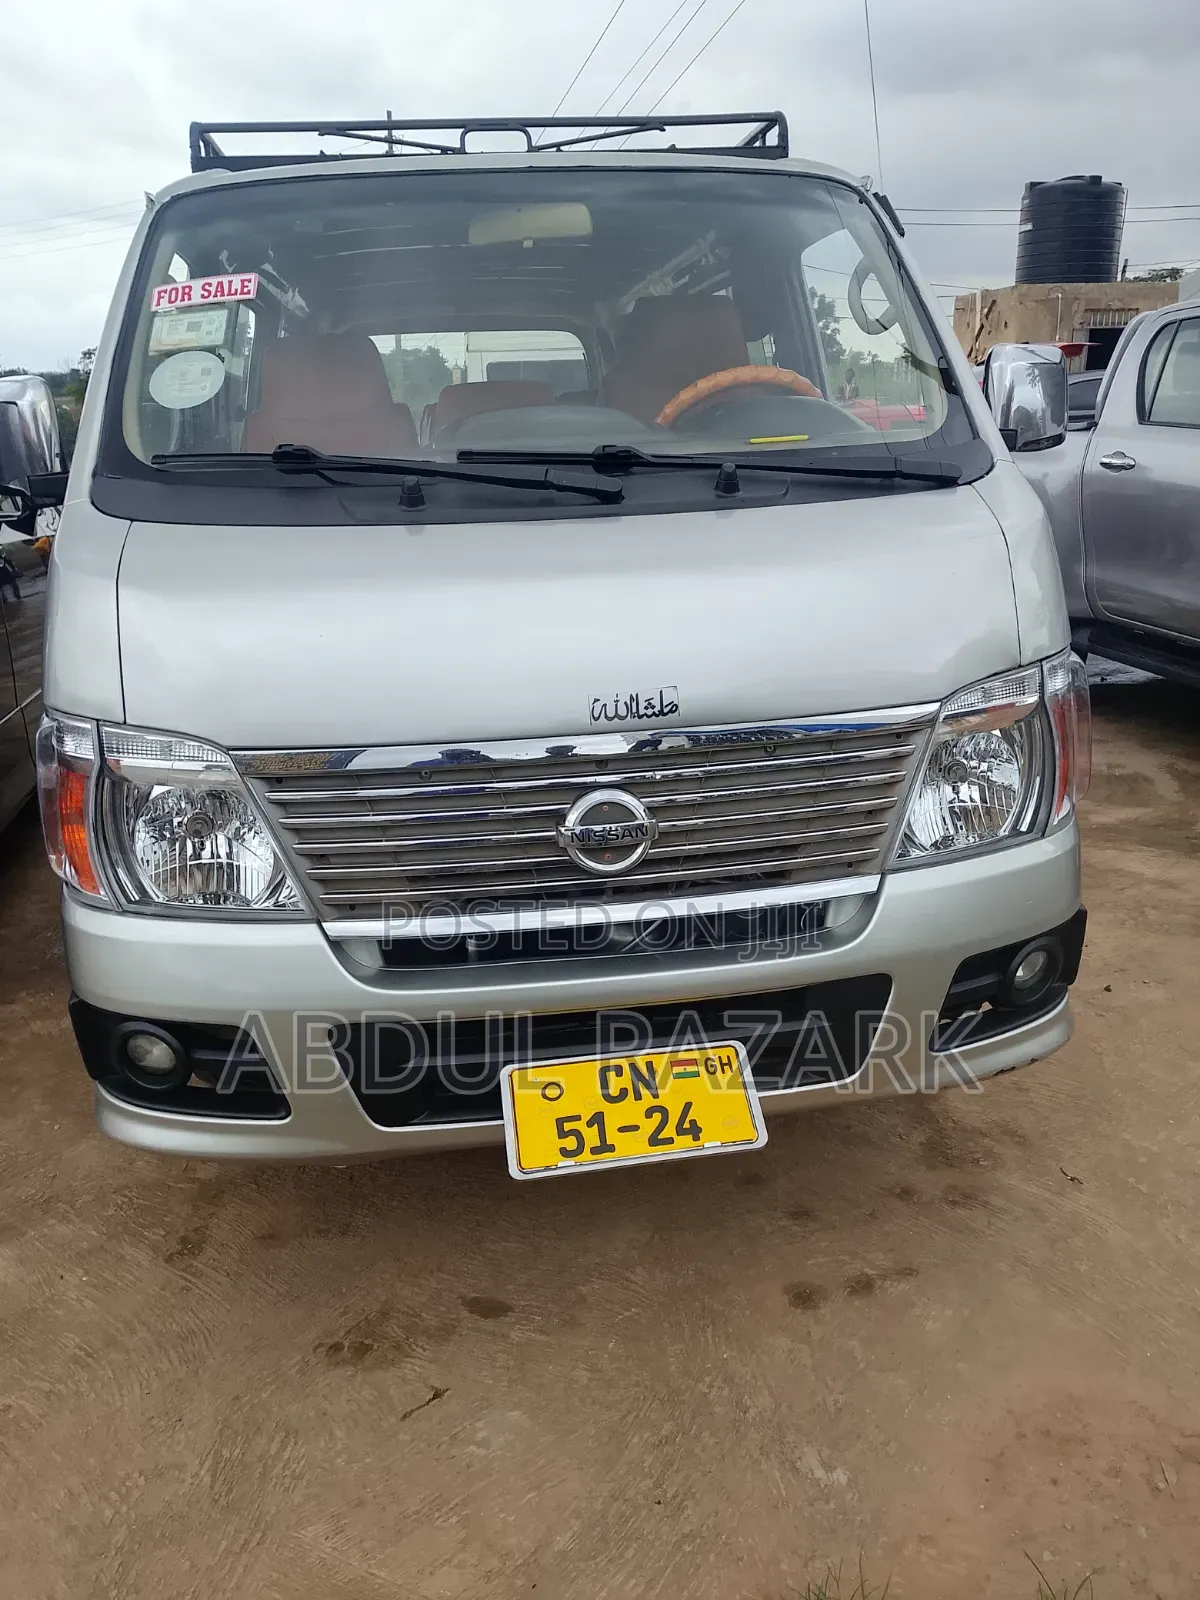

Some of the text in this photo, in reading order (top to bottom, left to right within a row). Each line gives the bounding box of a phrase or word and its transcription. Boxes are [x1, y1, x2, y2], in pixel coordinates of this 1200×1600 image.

[155, 278, 252, 307] FOR SALE
[571, 826, 648, 844] NISSAN
[598, 1054, 734, 1104] CN GH
[555, 1101, 703, 1159] 51-24
